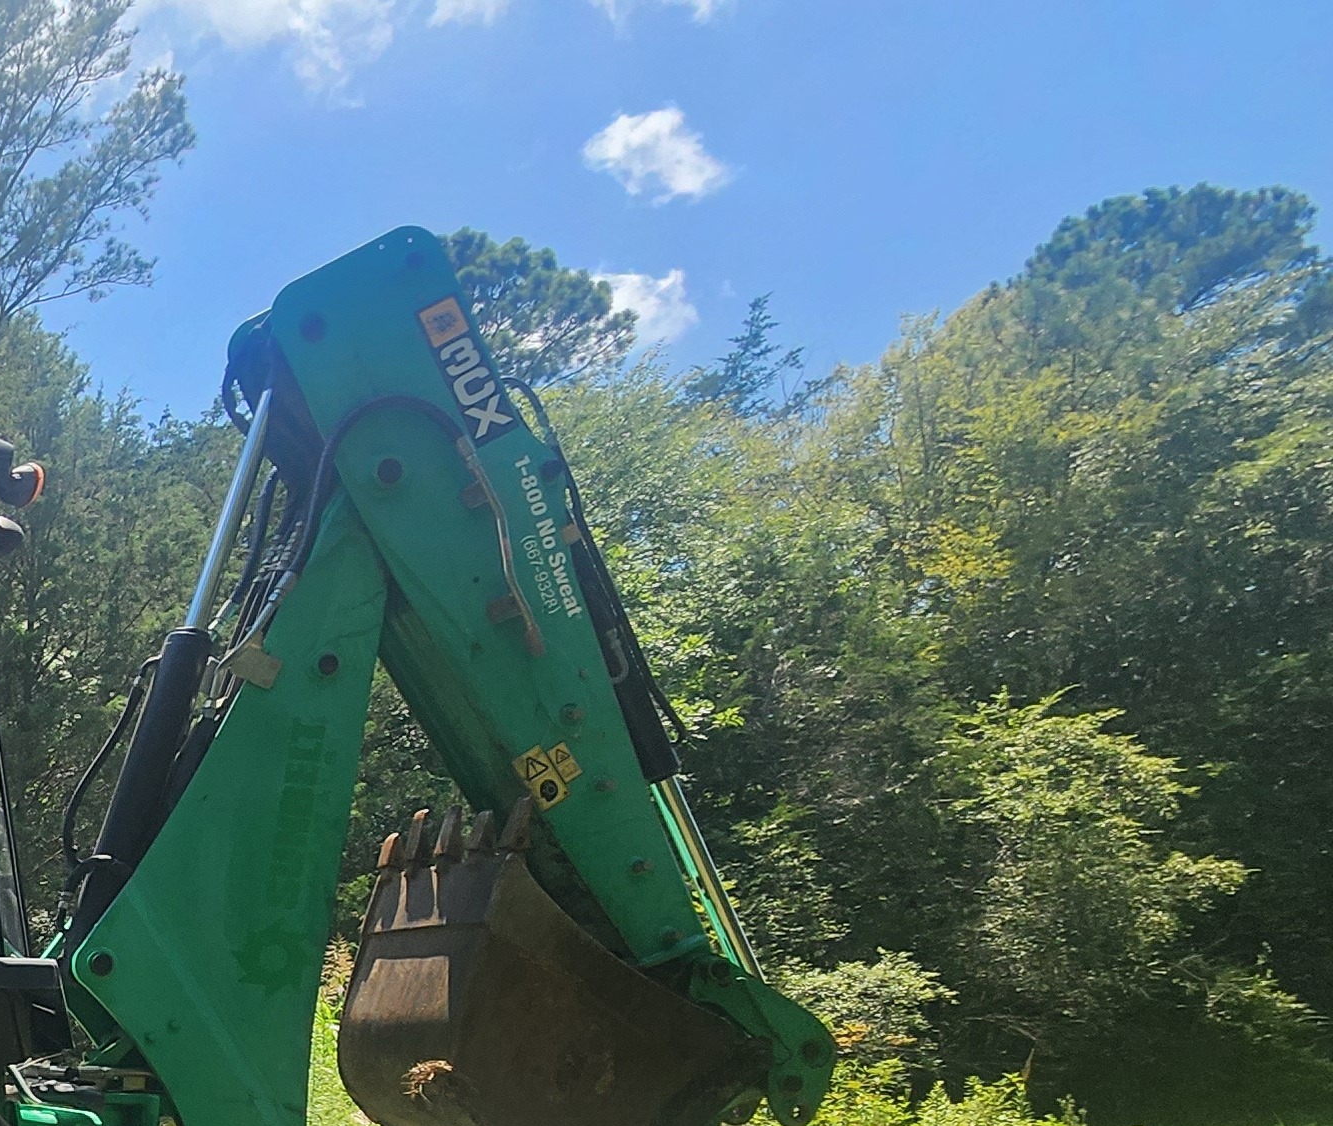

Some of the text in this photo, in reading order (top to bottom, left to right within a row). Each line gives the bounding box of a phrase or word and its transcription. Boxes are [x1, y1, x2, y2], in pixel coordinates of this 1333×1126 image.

[440, 337, 513, 440] 3CX
[515, 455, 583, 618] 1-800 No Sweat
[520, 534, 562, 615] (667-9328)
